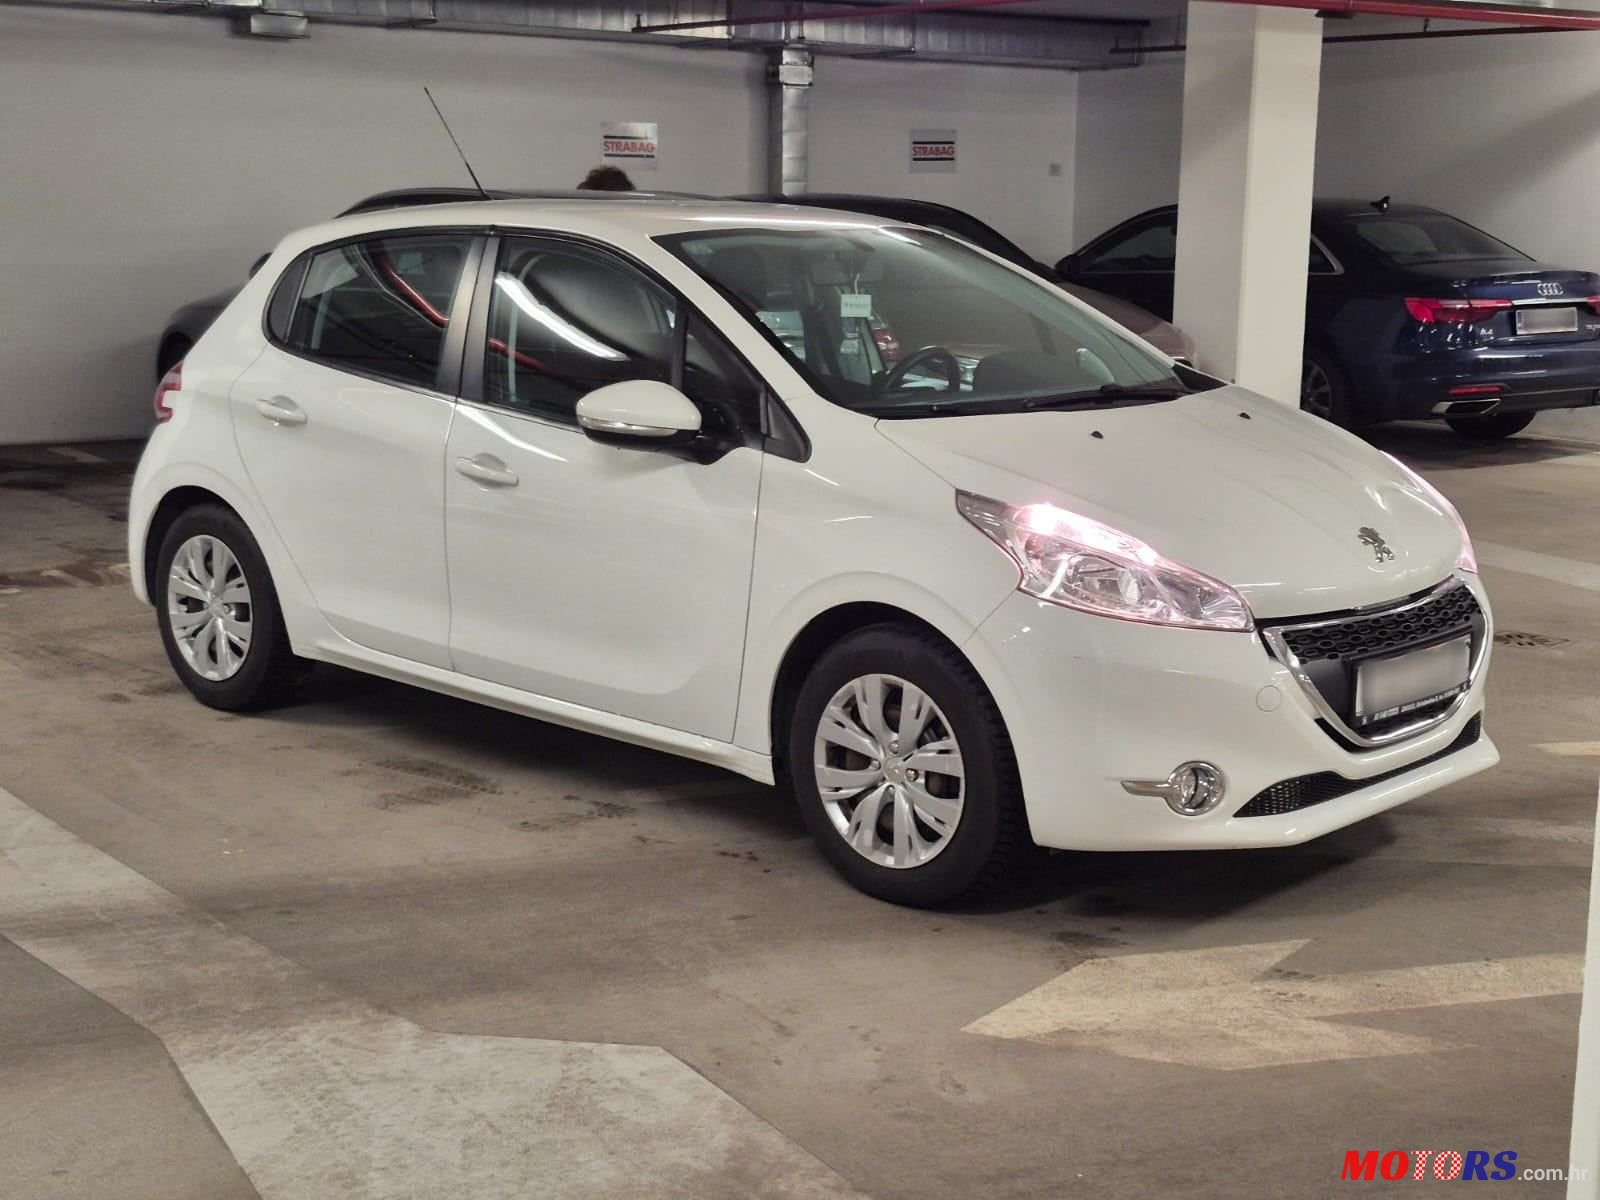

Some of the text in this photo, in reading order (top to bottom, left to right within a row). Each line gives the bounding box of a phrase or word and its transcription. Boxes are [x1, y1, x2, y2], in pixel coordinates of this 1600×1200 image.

[603, 141, 656, 153] STRABAG
[912, 146, 954, 156] STRABAG
[1480, 327, 1494, 335] A4
